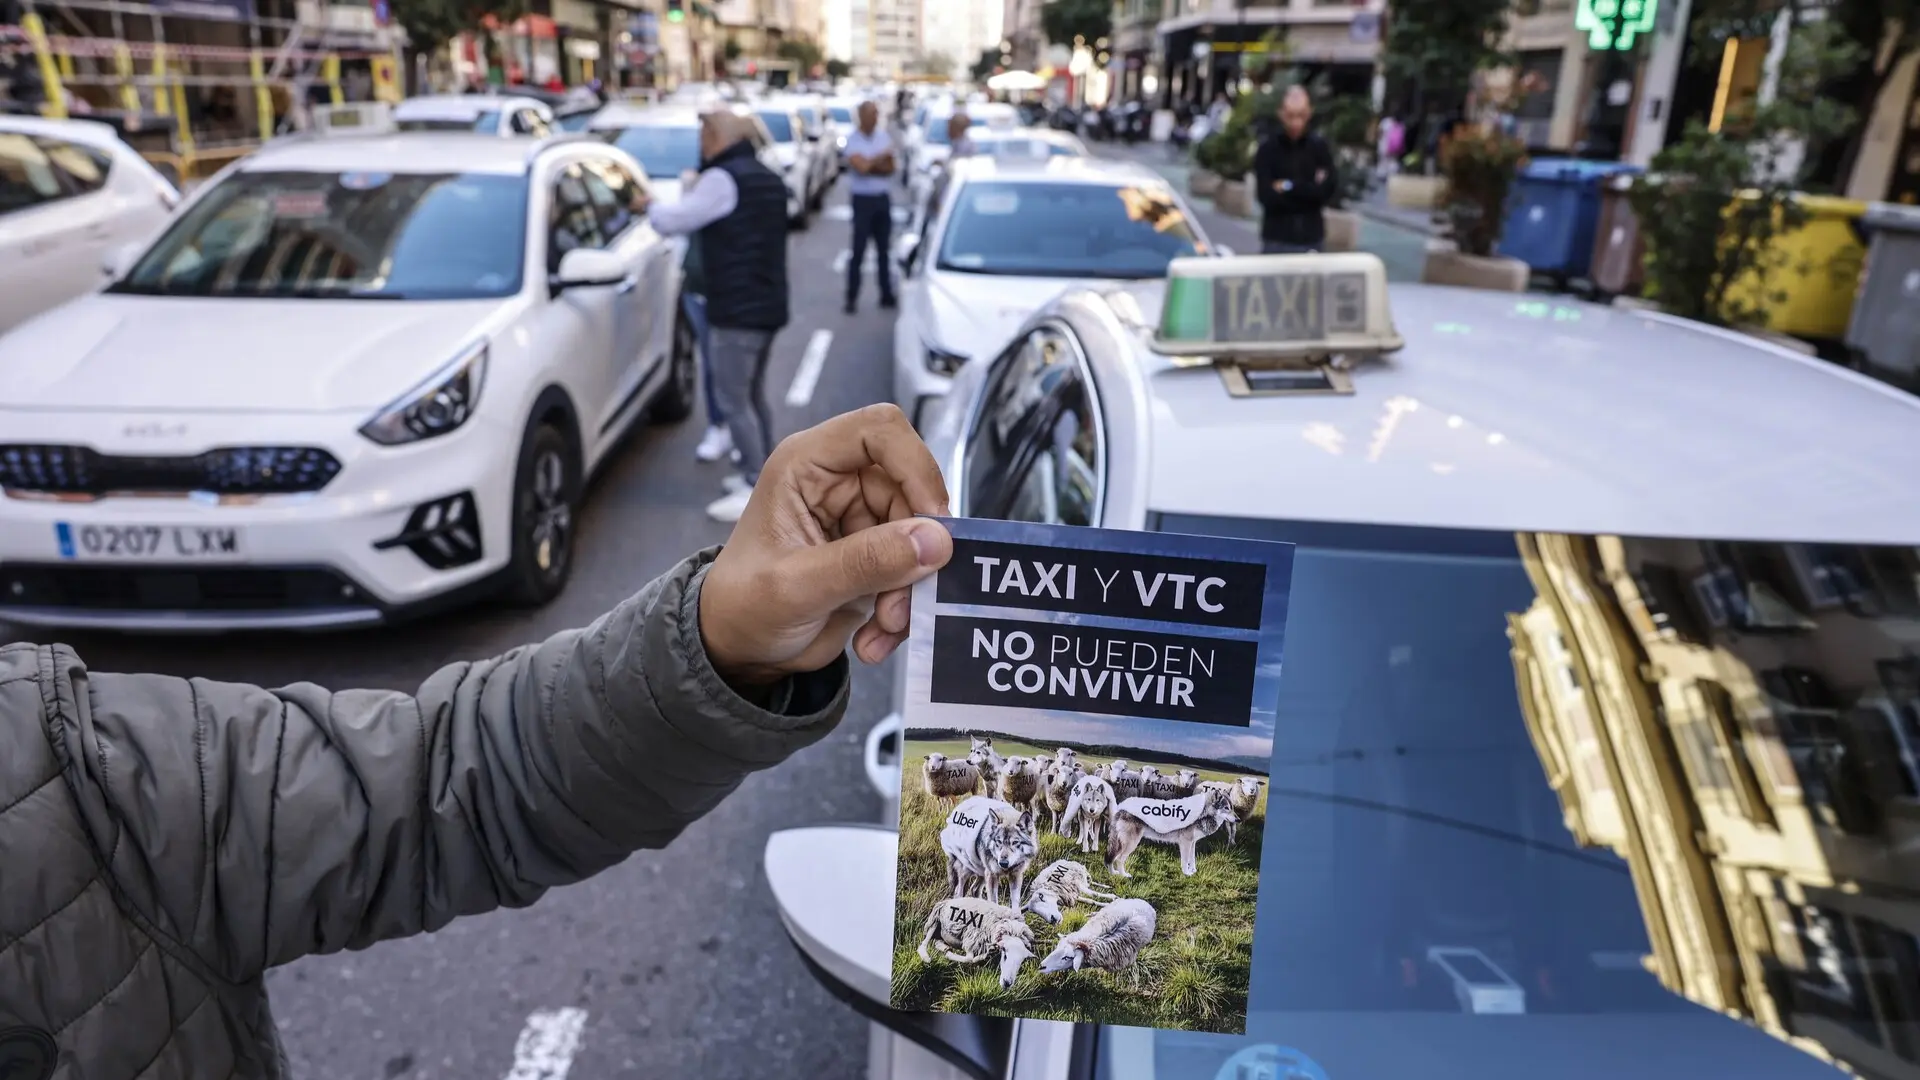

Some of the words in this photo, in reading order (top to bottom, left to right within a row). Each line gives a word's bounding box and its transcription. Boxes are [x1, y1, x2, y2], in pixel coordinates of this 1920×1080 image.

[1220, 274, 1320, 331] TAXI
[80, 525, 162, 554] 0207
[173, 526, 239, 556] LXW
[973, 555, 1077, 600] TAXI
[1093, 567, 1121, 603] Y
[1132, 570, 1227, 613] VTC
[971, 627, 1035, 661] NO
[1050, 635, 1216, 678] PUEDEN
[987, 661, 1196, 708] CONVIVIR
[946, 768, 967, 779] TAXI
[1121, 778, 1139, 789] TAXI
[1155, 782, 1176, 793] TAXI
[952, 811, 979, 829] Uber
[1141, 803, 1191, 821] cabify
[1047, 864, 1070, 885] TAXI
[949, 906, 984, 929] TAXI
